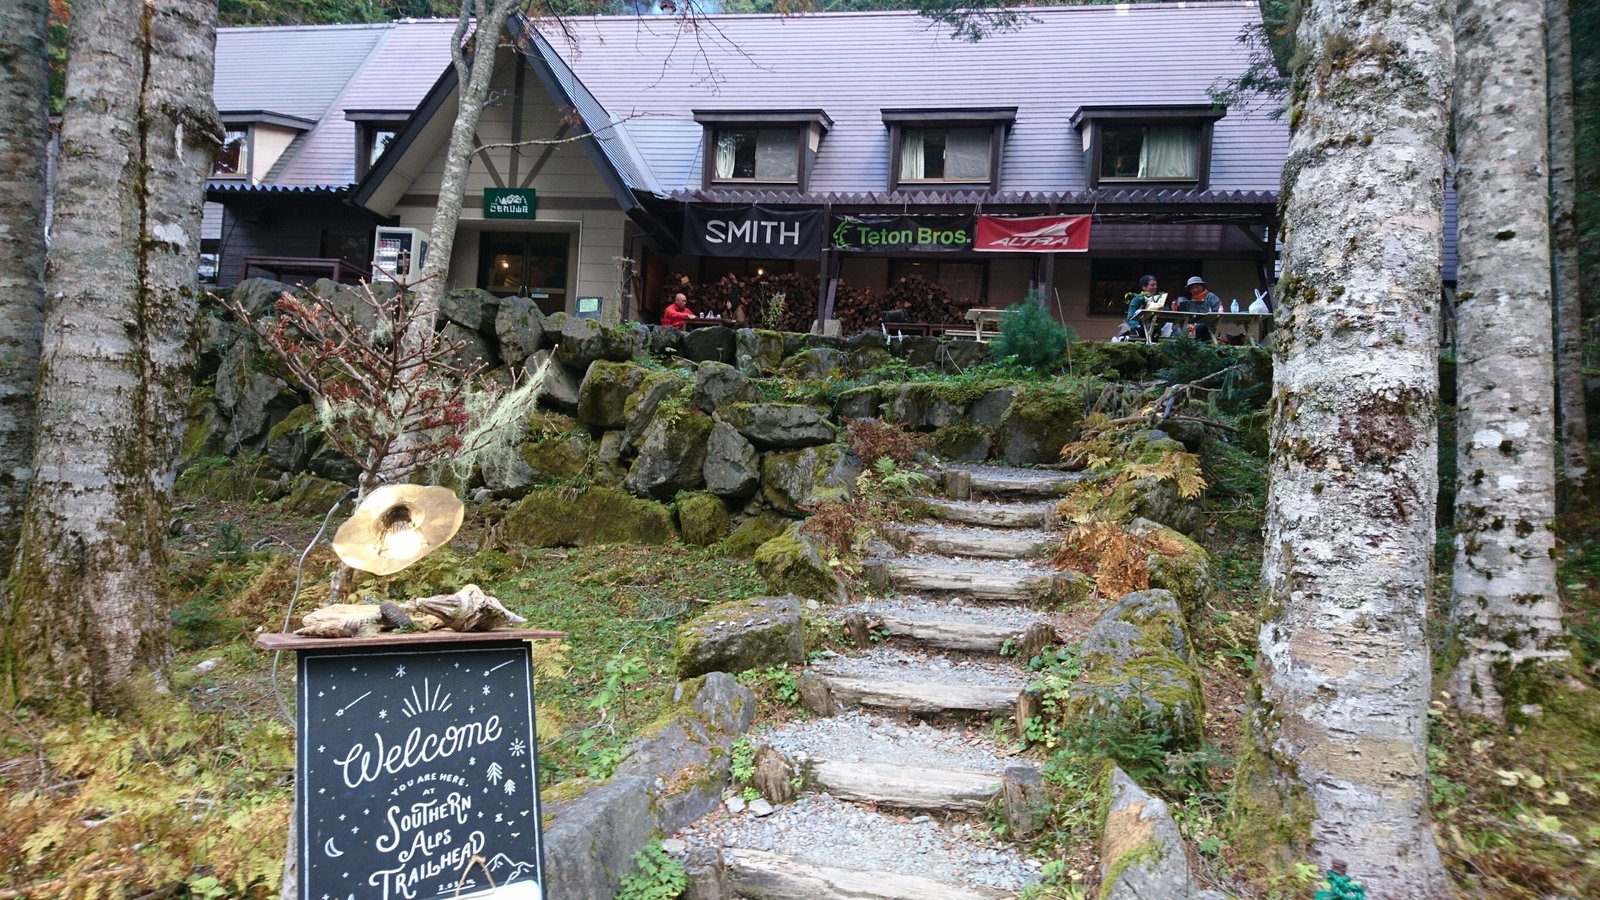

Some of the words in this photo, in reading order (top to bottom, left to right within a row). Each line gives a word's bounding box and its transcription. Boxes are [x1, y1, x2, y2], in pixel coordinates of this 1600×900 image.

[705, 218, 801, 246] SMITH
[857, 226, 914, 246] Teton
[918, 227, 972, 245] Bros.
[988, 235, 1070, 248] ALTRA
[333, 714, 503, 788] Welcome
[390, 779, 414, 796] YOU
[416, 772, 437, 785] ARE
[422, 787, 436, 796] AT
